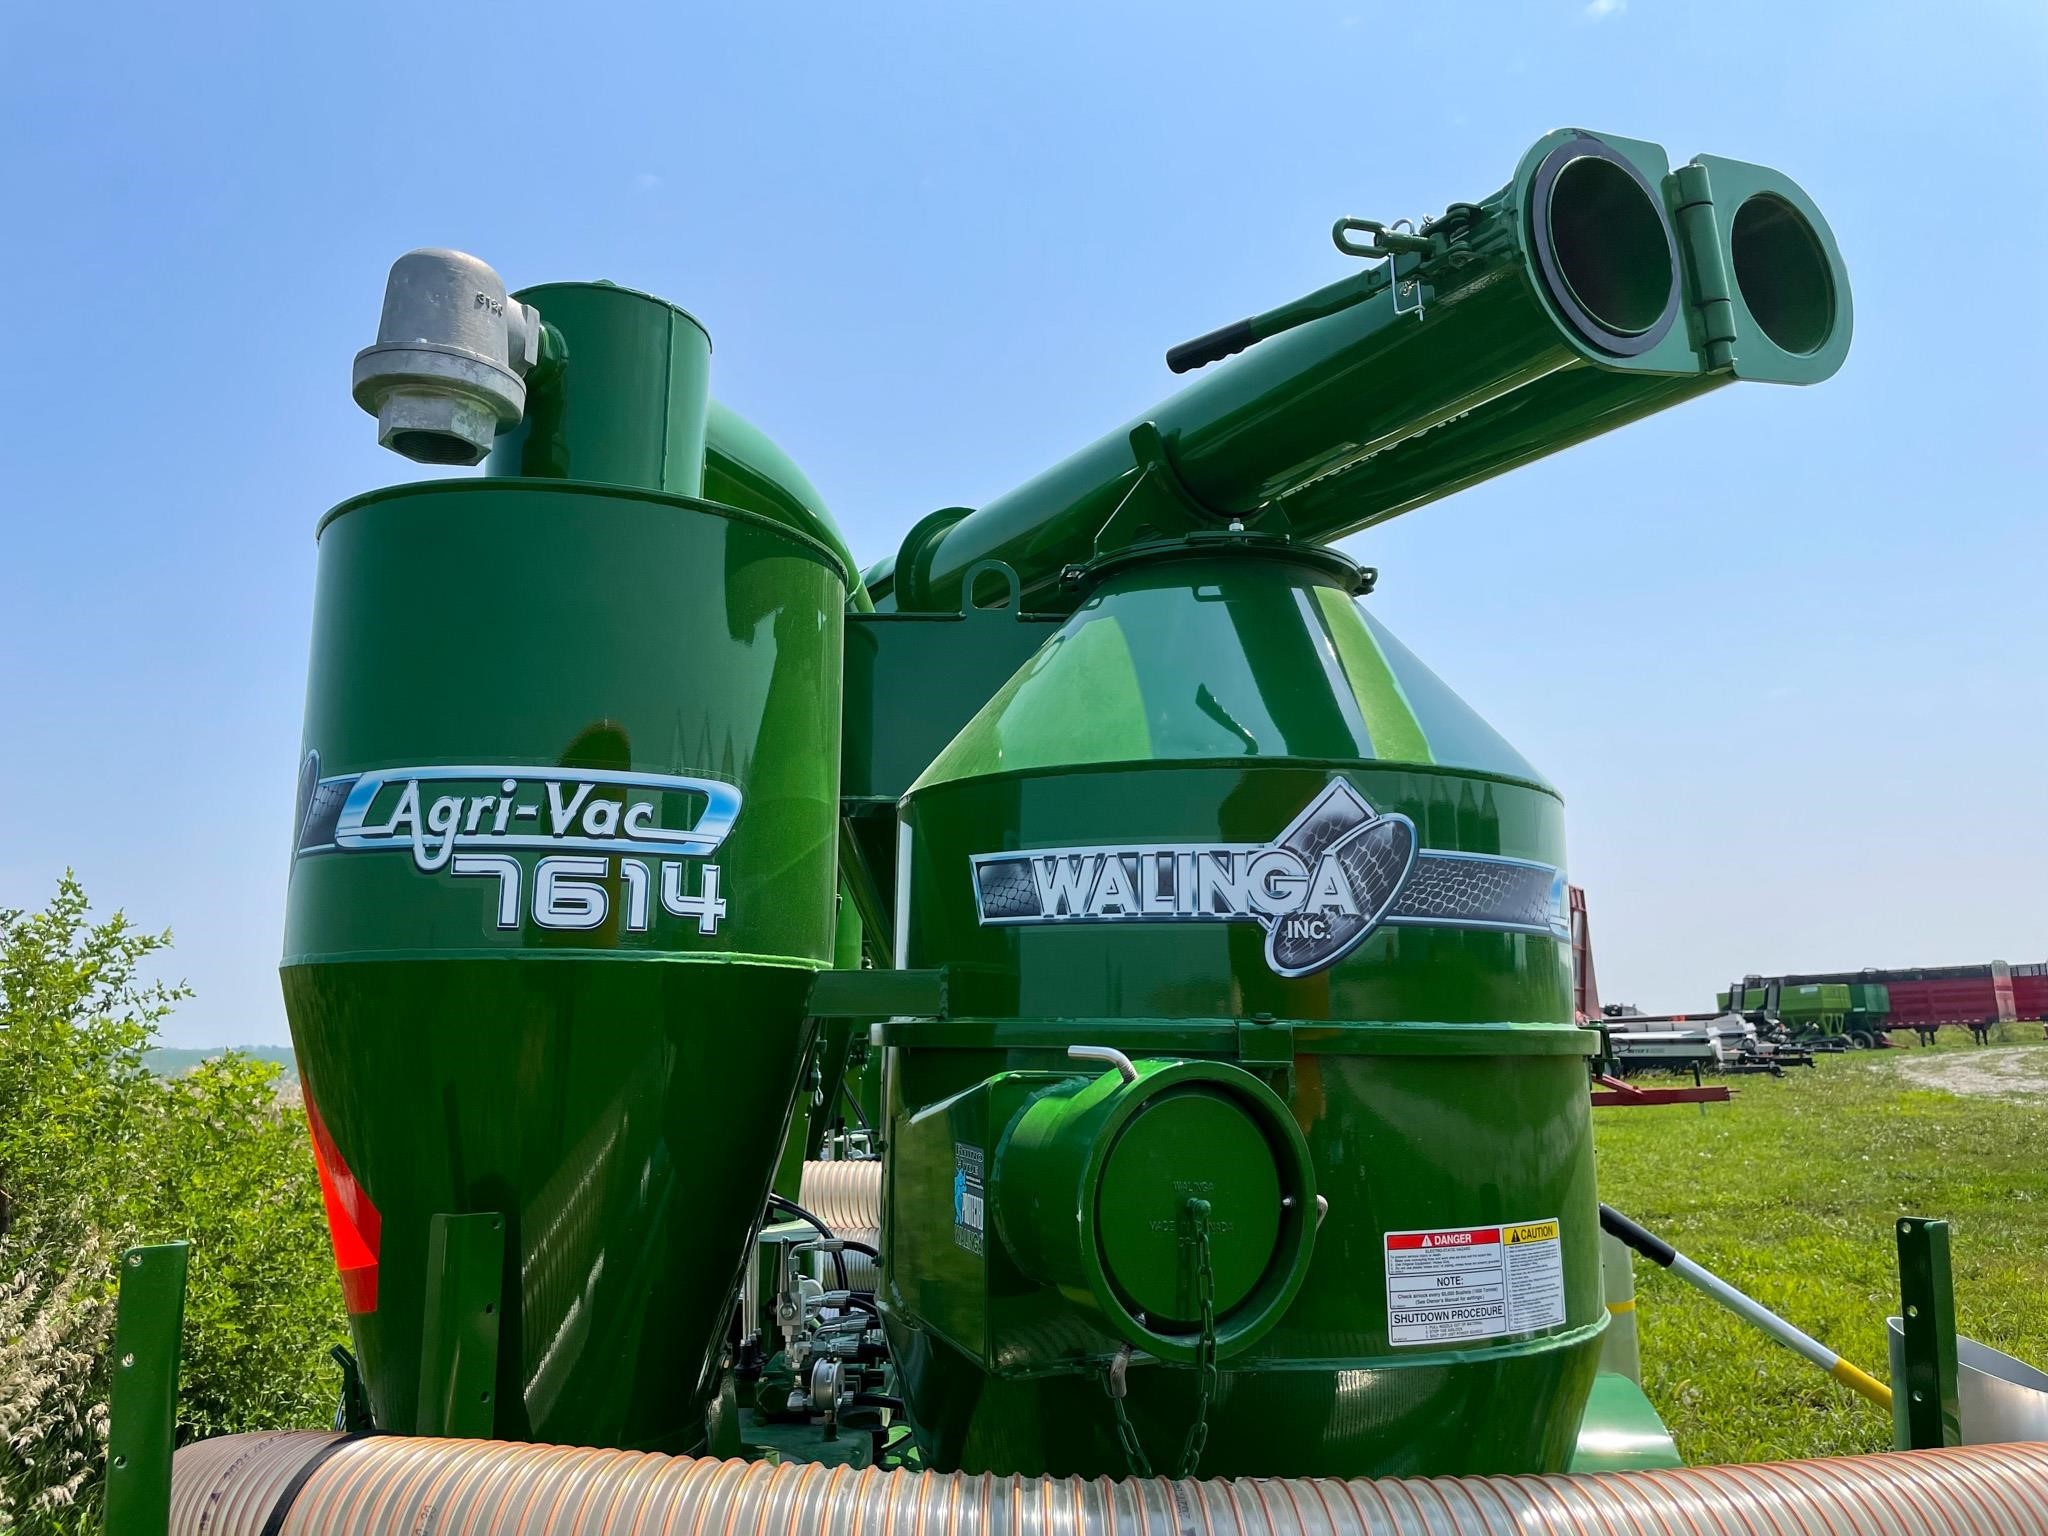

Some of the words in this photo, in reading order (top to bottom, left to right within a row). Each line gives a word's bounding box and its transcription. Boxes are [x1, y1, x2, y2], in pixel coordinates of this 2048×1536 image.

[384, 778, 655, 871] Agri-Vac
[451, 853, 726, 935] 7614
[1032, 851, 1359, 918] WALINGA
[1287, 919, 1332, 940] INC.
[1434, 1233, 1472, 1246] DANGER
[1520, 1225, 1553, 1240] CAUTION
[1436, 1275, 1464, 1287] NOTE:
[1394, 1312, 1450, 1324] SHUTDOWN
[1451, 1305, 1503, 1320] PROCEDURE
